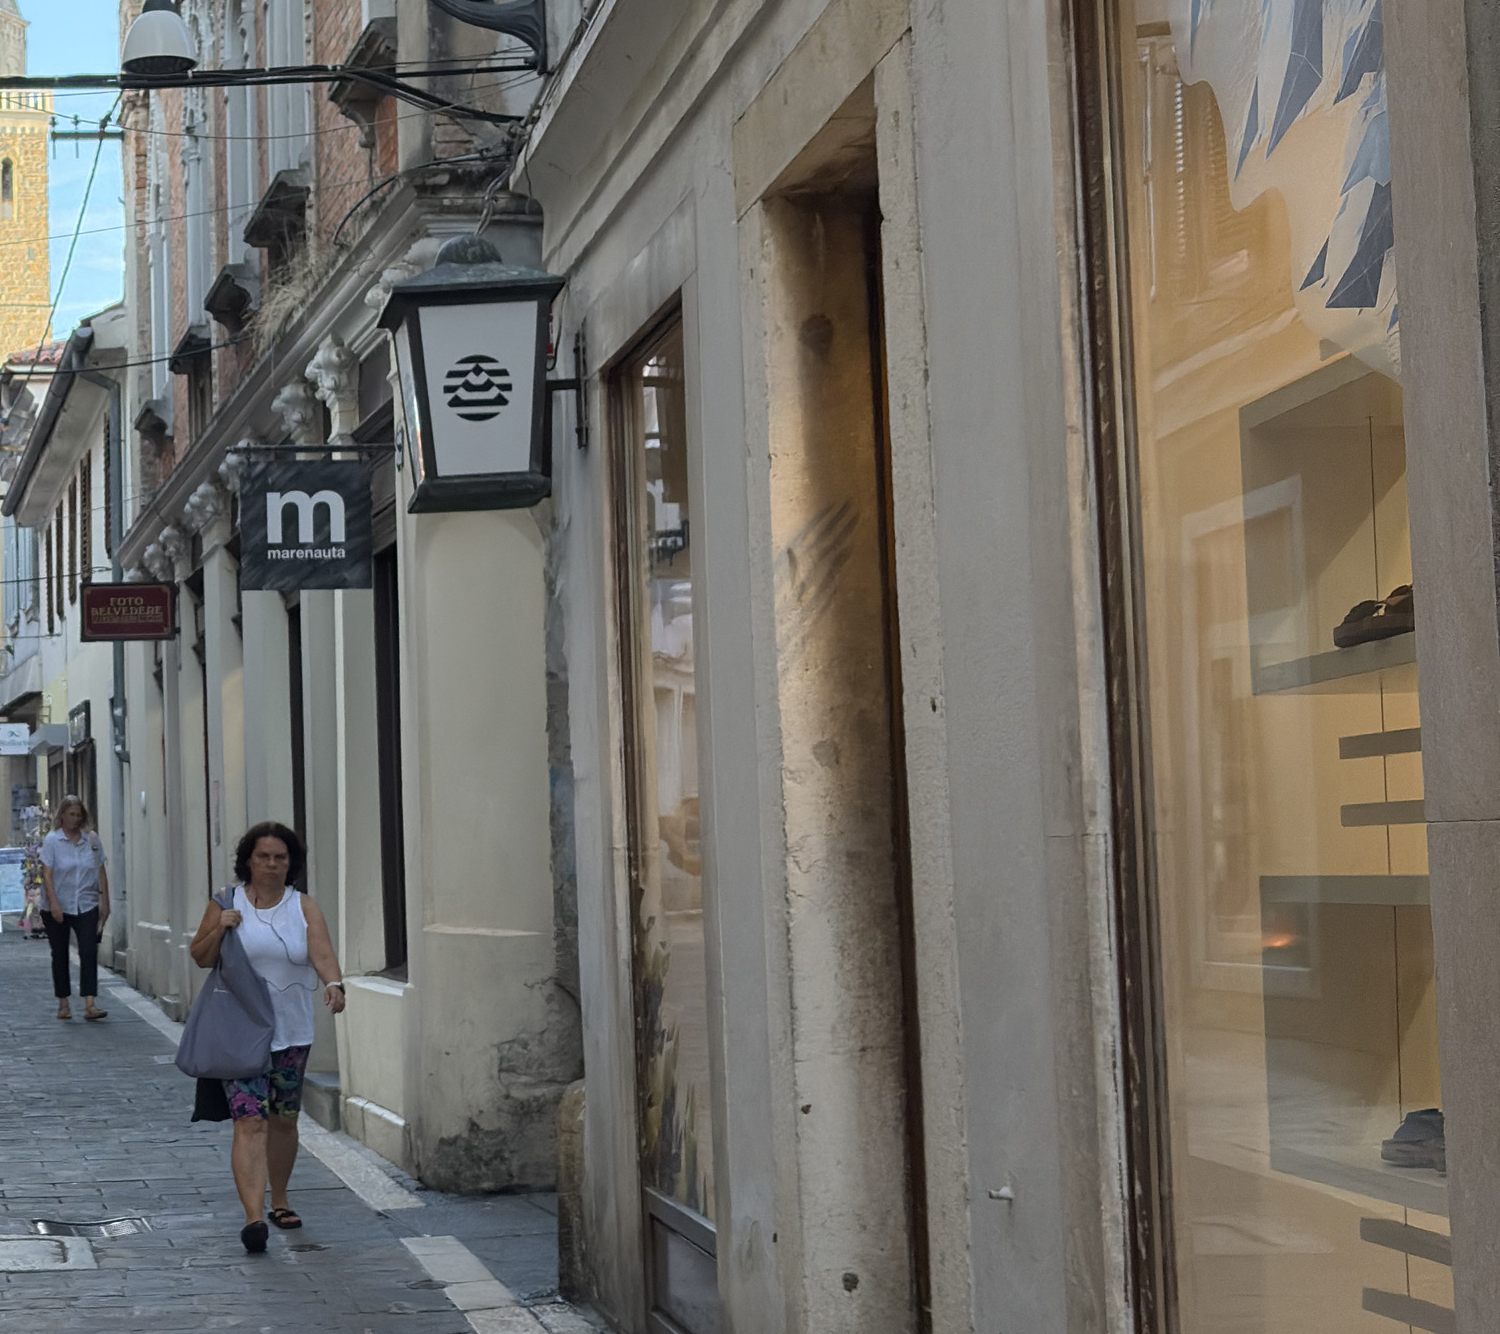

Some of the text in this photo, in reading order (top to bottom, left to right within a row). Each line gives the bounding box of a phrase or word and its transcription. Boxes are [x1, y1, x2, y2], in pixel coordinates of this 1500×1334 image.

[266, 490, 346, 543] m
[267, 547, 346, 560] marenauta
[109, 596, 144, 606] FOTO
[91, 605, 163, 616] BELVEDERE
